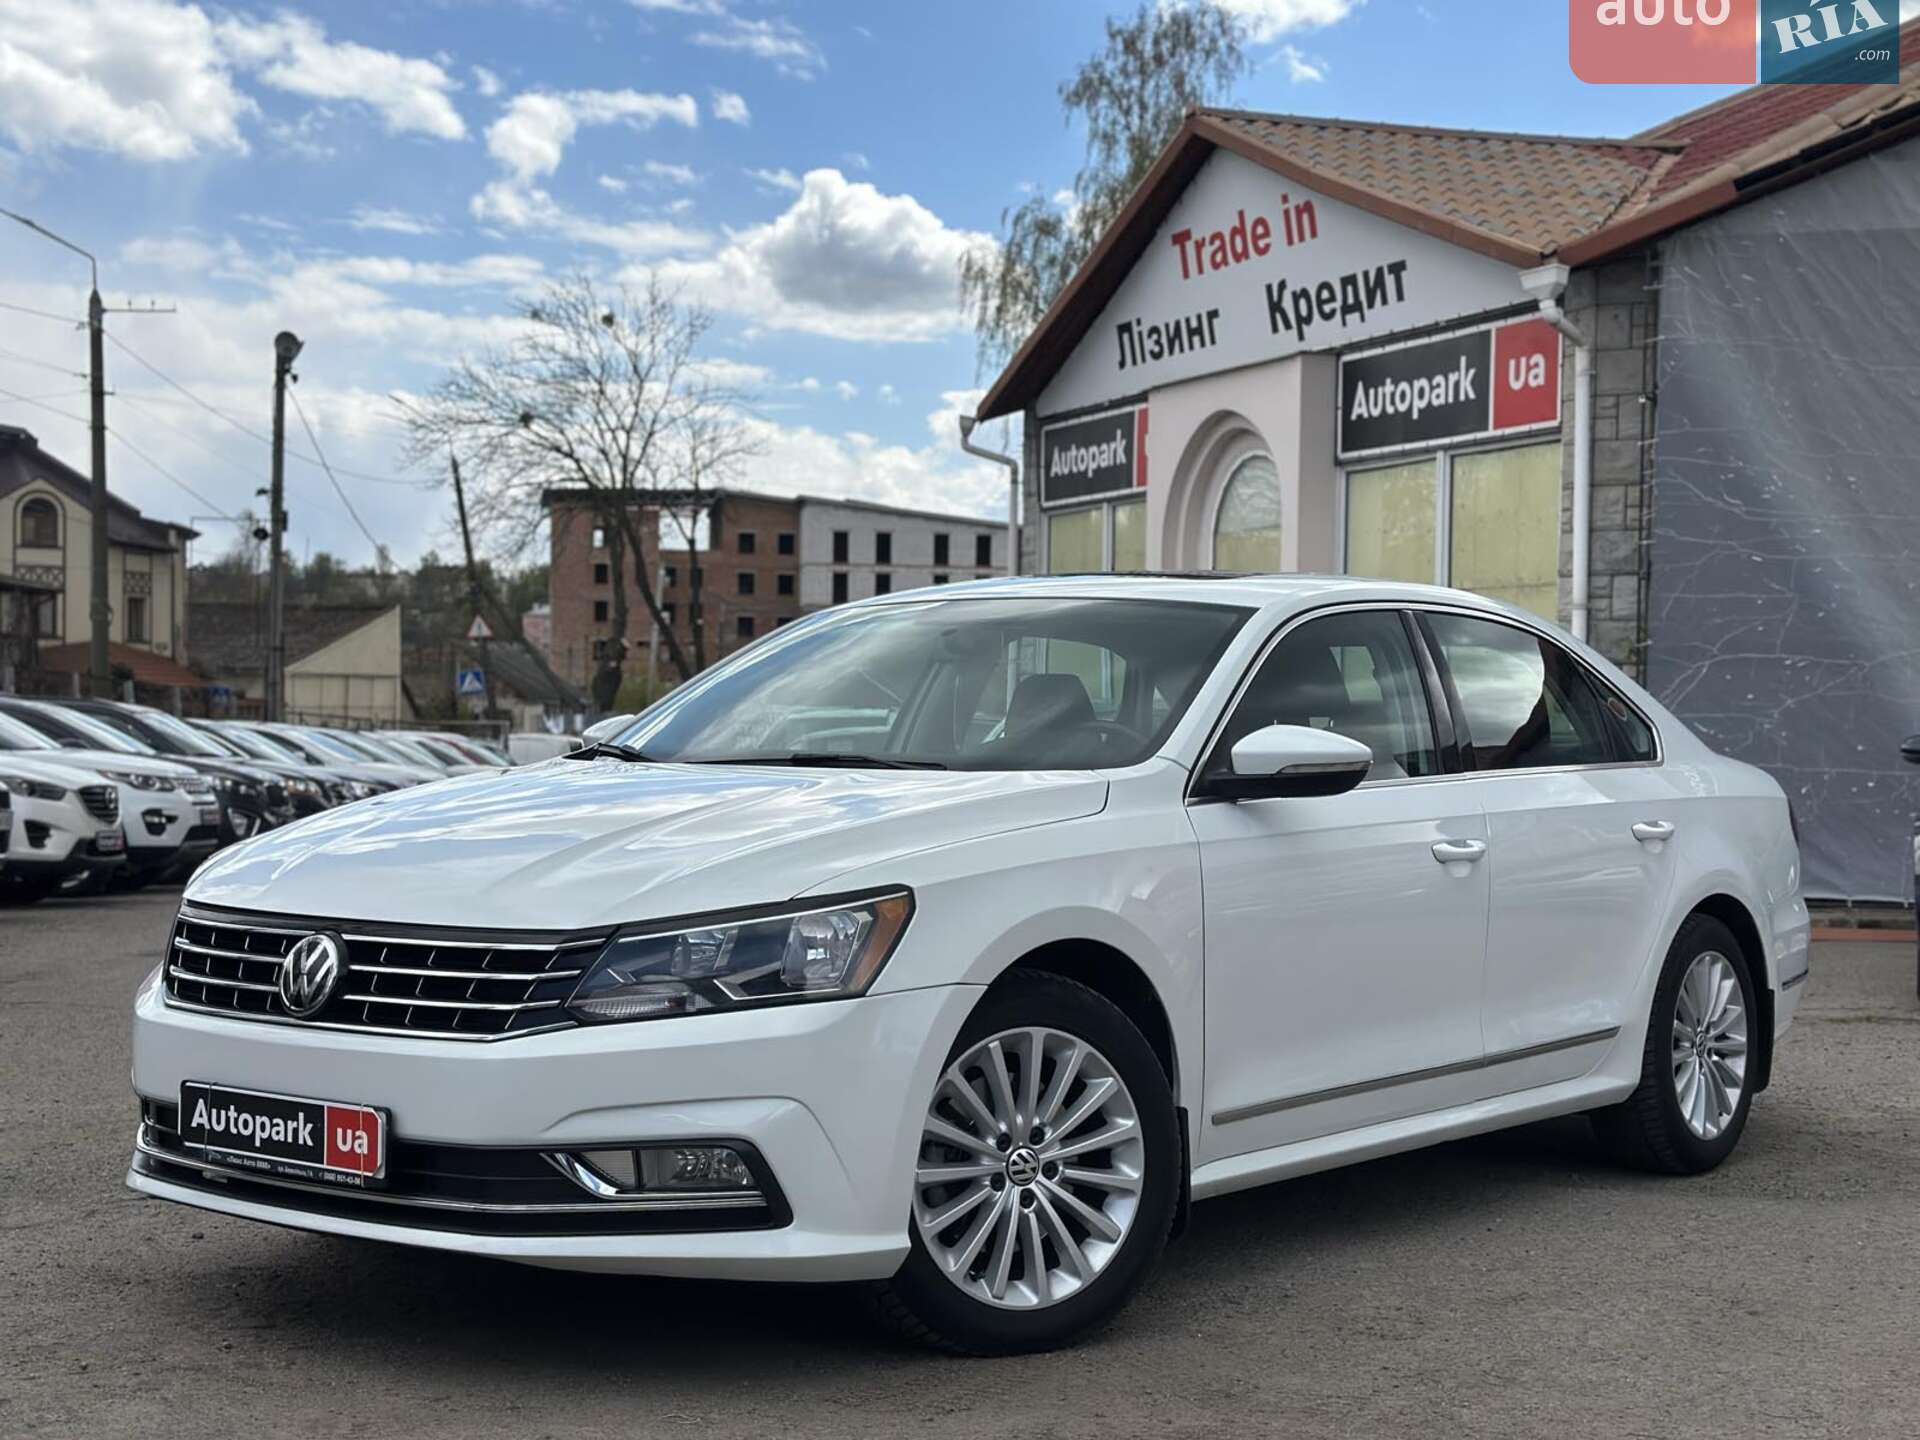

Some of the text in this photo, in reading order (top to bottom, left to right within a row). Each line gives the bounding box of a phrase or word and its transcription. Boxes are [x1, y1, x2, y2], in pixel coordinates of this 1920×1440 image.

[1171, 193, 1318, 280] Trade in
[1116, 259, 1408, 371] Лізинг Кредит
[1351, 353, 1546, 421] Autopark ua
[1050, 428, 1127, 478] Autopark
[191, 1098, 368, 1155] Autopark ua
